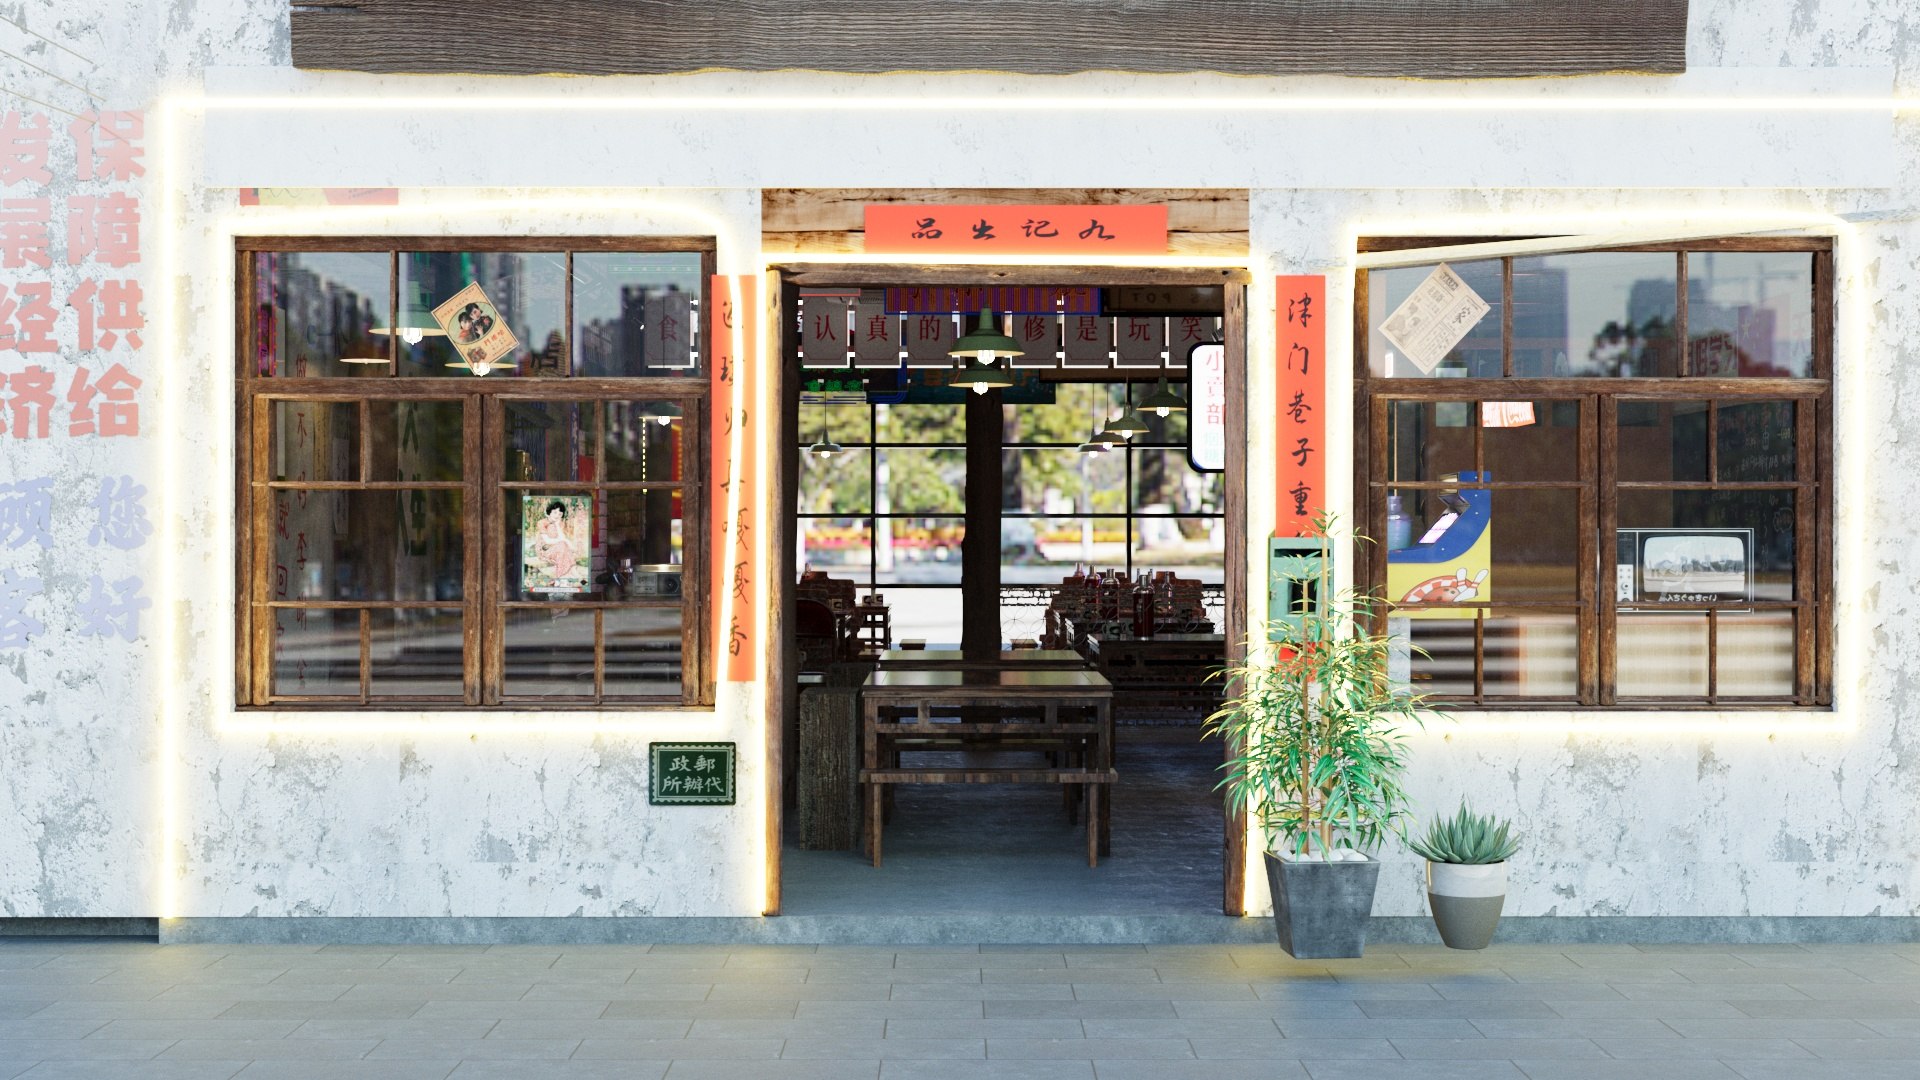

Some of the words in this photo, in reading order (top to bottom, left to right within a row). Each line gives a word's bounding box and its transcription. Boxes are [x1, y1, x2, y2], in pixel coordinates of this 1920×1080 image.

[65, 108, 147, 440] 保障供给
[814, 314, 1203, 342] 认真的修是玩笑
[1286, 292, 1314, 537] 津门巷子重
[76, 474, 155, 644] 您好
